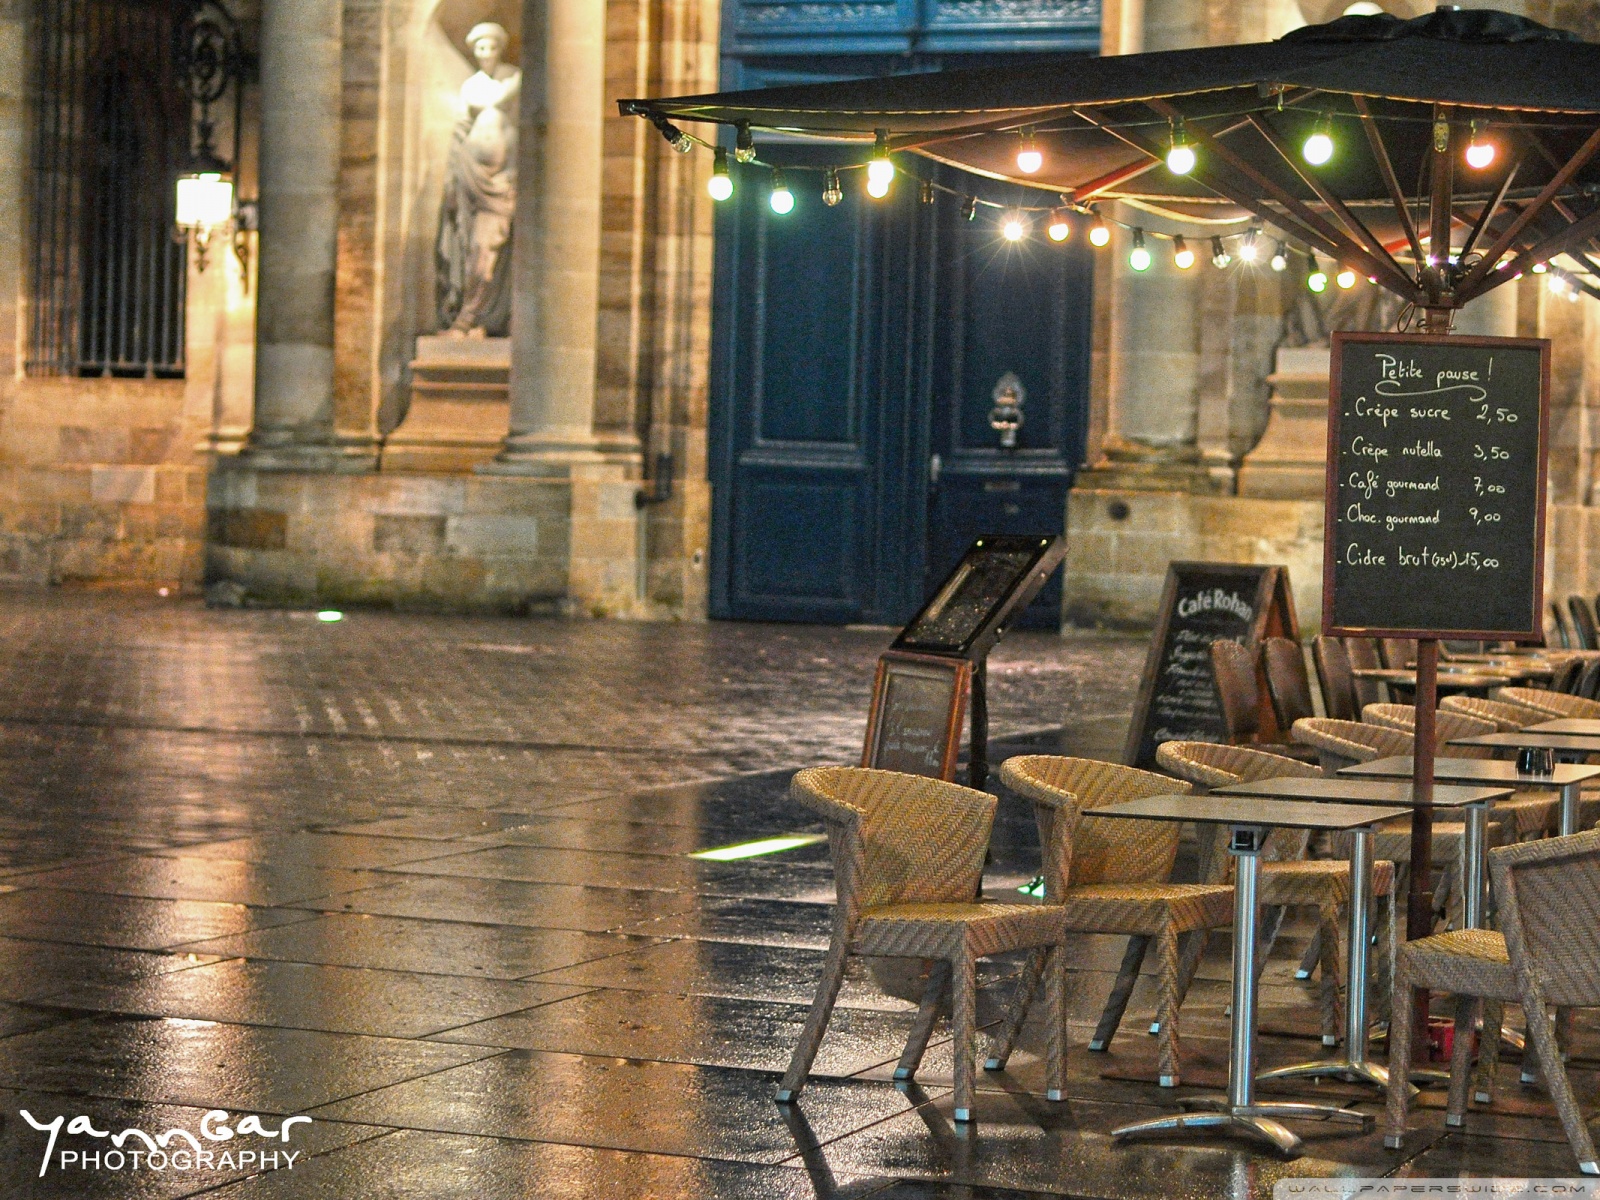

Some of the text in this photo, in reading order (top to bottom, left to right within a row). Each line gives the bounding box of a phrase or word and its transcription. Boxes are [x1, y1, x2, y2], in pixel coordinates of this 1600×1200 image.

[1375, 353, 1423, 379] Petite
[1436, 369, 1479, 388] pause
[1410, 406, 1451, 421] sucre
[1476, 403, 1518, 426] 2,50
[1402, 440, 1442, 457] nutella
[1473, 444, 1510, 462] 3,50
[1349, 470, 1506, 500] Café gourmand 7,00
[1347, 503, 1501, 531] Choc. gourmand 9,00
[1347, 543, 1386, 566] Cidre
[1399, 545, 1429, 566] brut
[1178, 588, 1253, 622] Café Rohan
